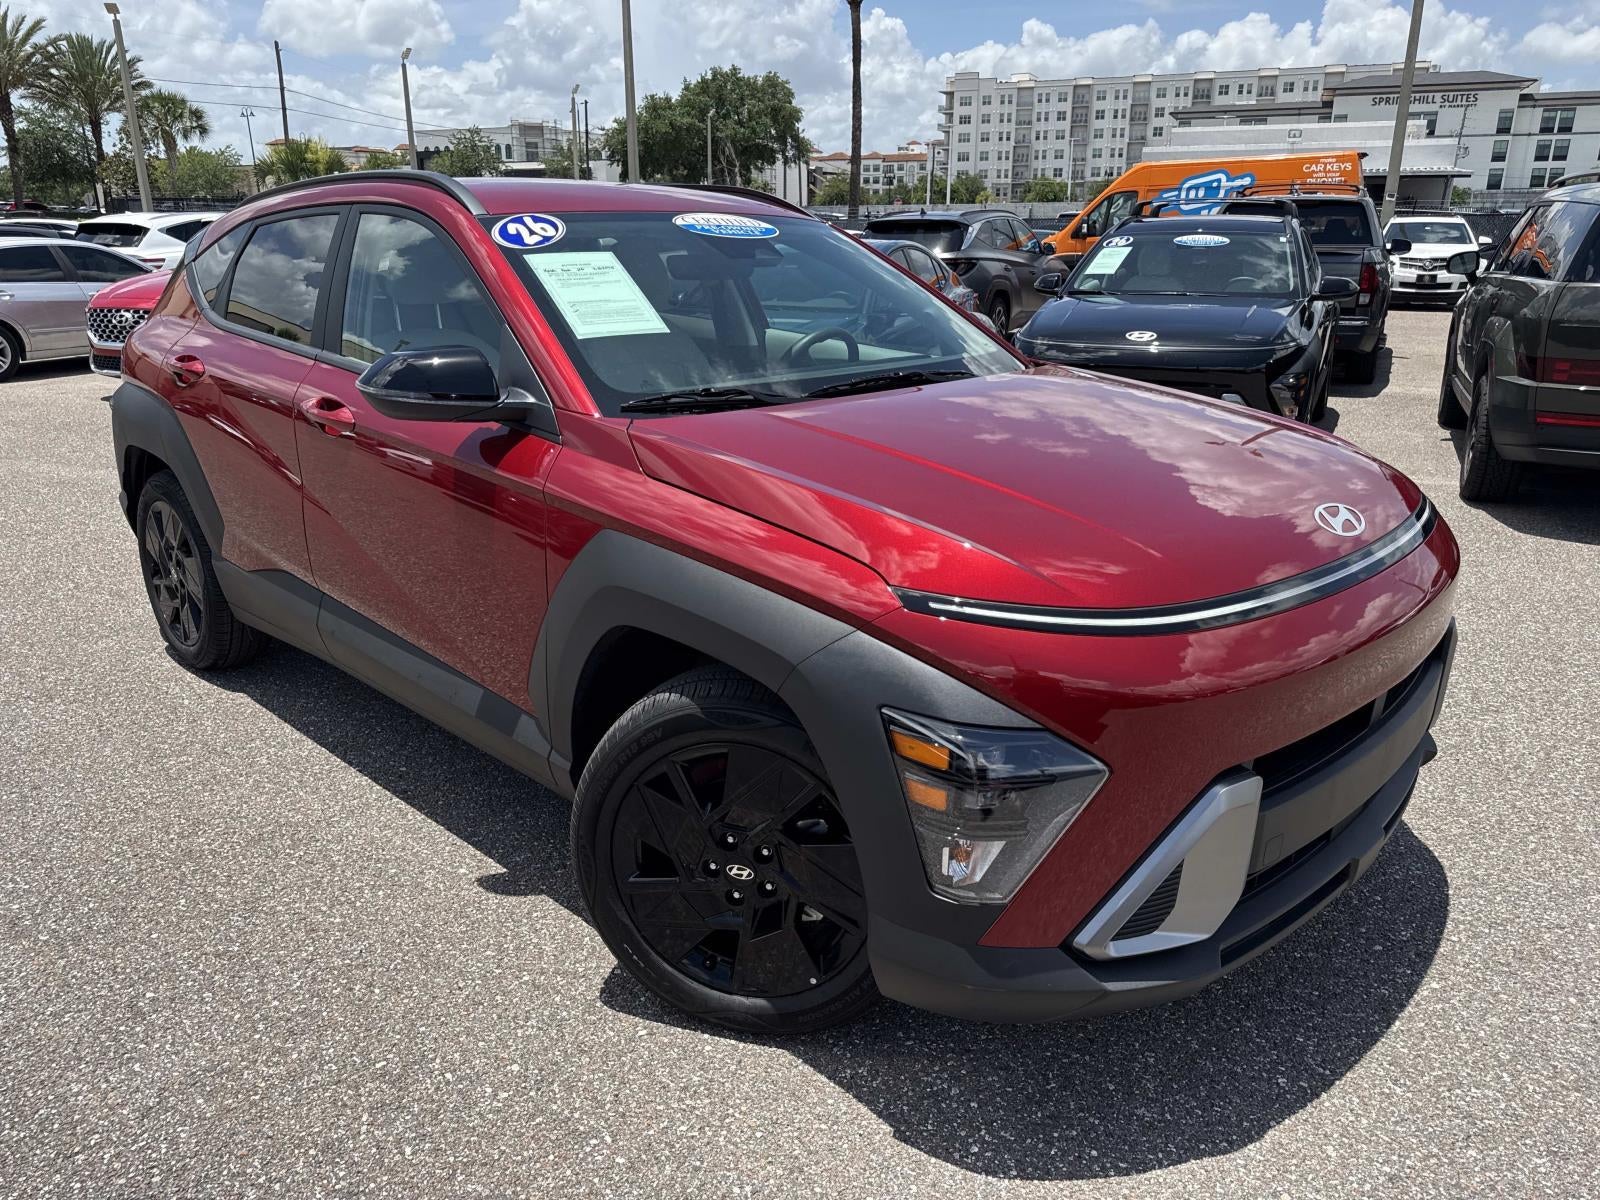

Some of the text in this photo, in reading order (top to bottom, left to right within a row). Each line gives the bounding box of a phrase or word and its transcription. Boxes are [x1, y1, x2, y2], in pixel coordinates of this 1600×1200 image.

[1440, 93, 1478, 103] SUITES
[1303, 162, 1352, 172] CAR KEYS
[507, 216, 556, 244] 26
